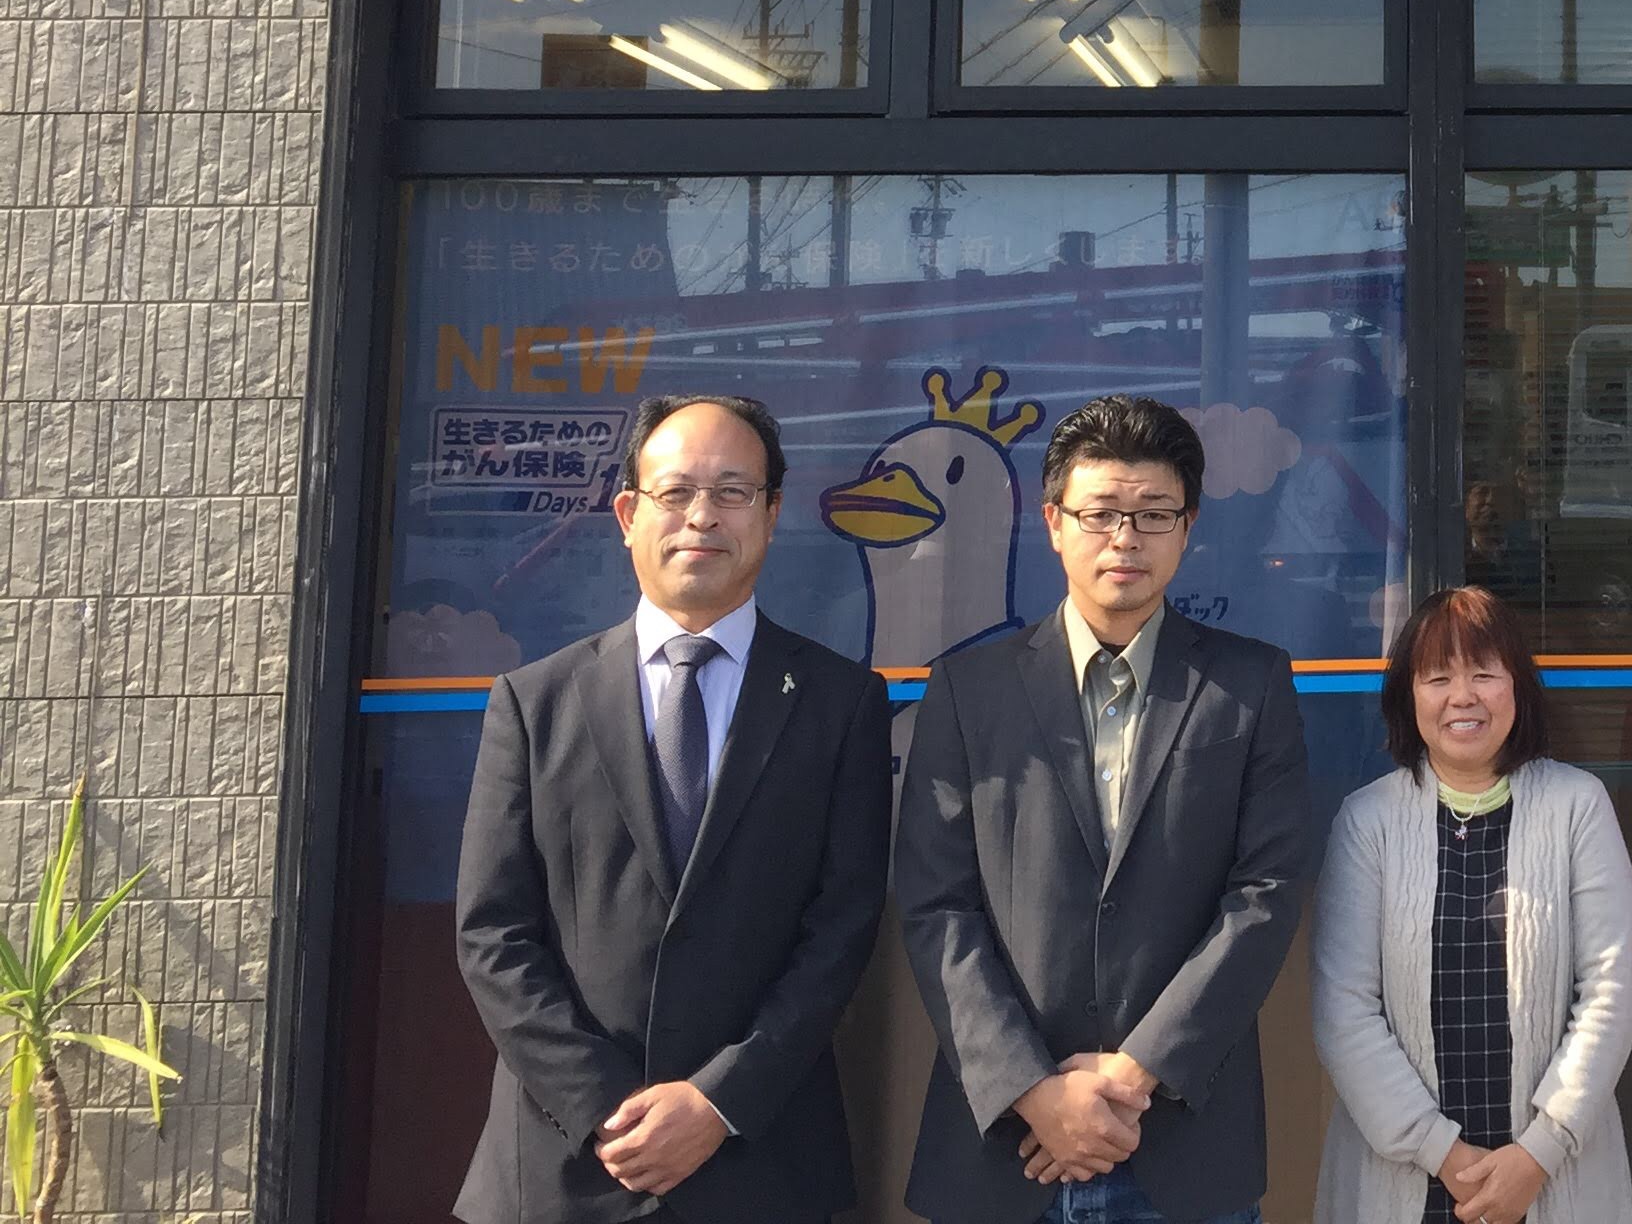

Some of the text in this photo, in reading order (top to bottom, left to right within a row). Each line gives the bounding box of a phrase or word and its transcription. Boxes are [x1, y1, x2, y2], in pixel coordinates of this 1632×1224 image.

[435, 324, 656, 394] NEW
[442, 418, 612, 447] 生きるための
[440, 449, 588, 478] がん保険
